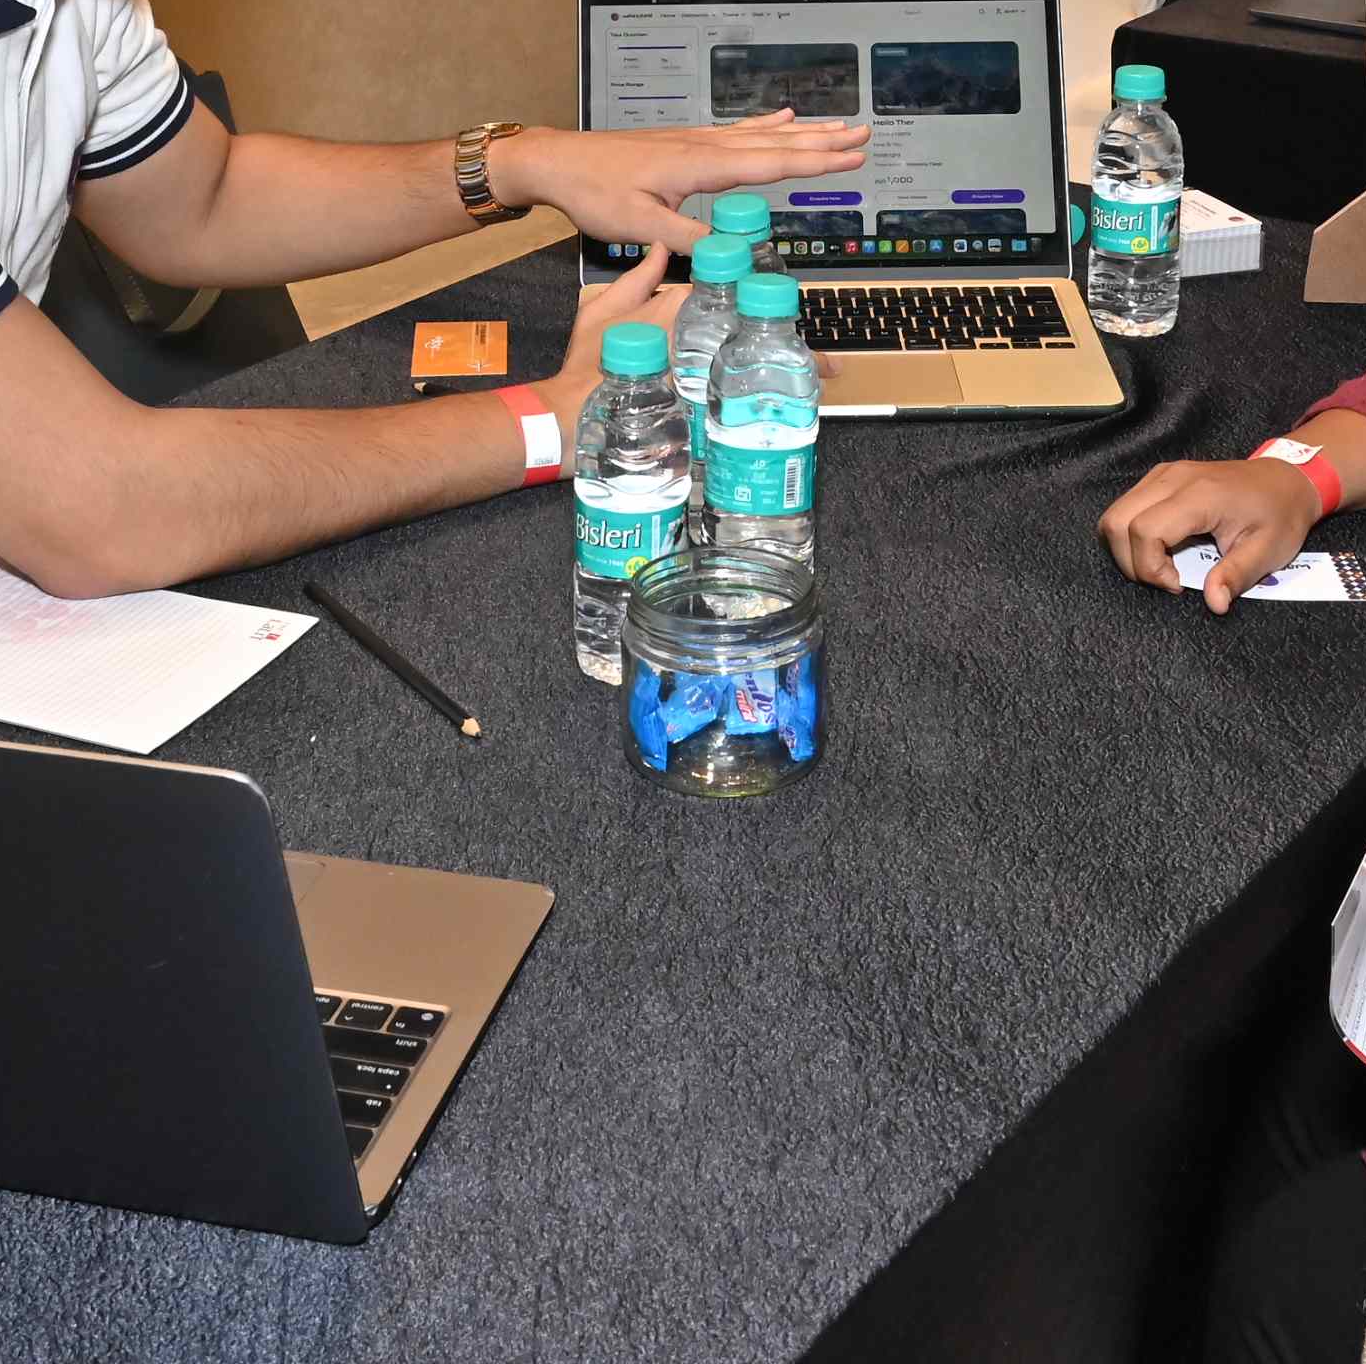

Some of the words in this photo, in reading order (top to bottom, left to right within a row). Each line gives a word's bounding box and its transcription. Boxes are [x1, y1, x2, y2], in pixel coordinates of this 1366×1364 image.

[1092, 206, 1145, 231] Bisleri
[576, 512, 643, 550] Bisleri
[365, 1098, 383, 1108] tab
